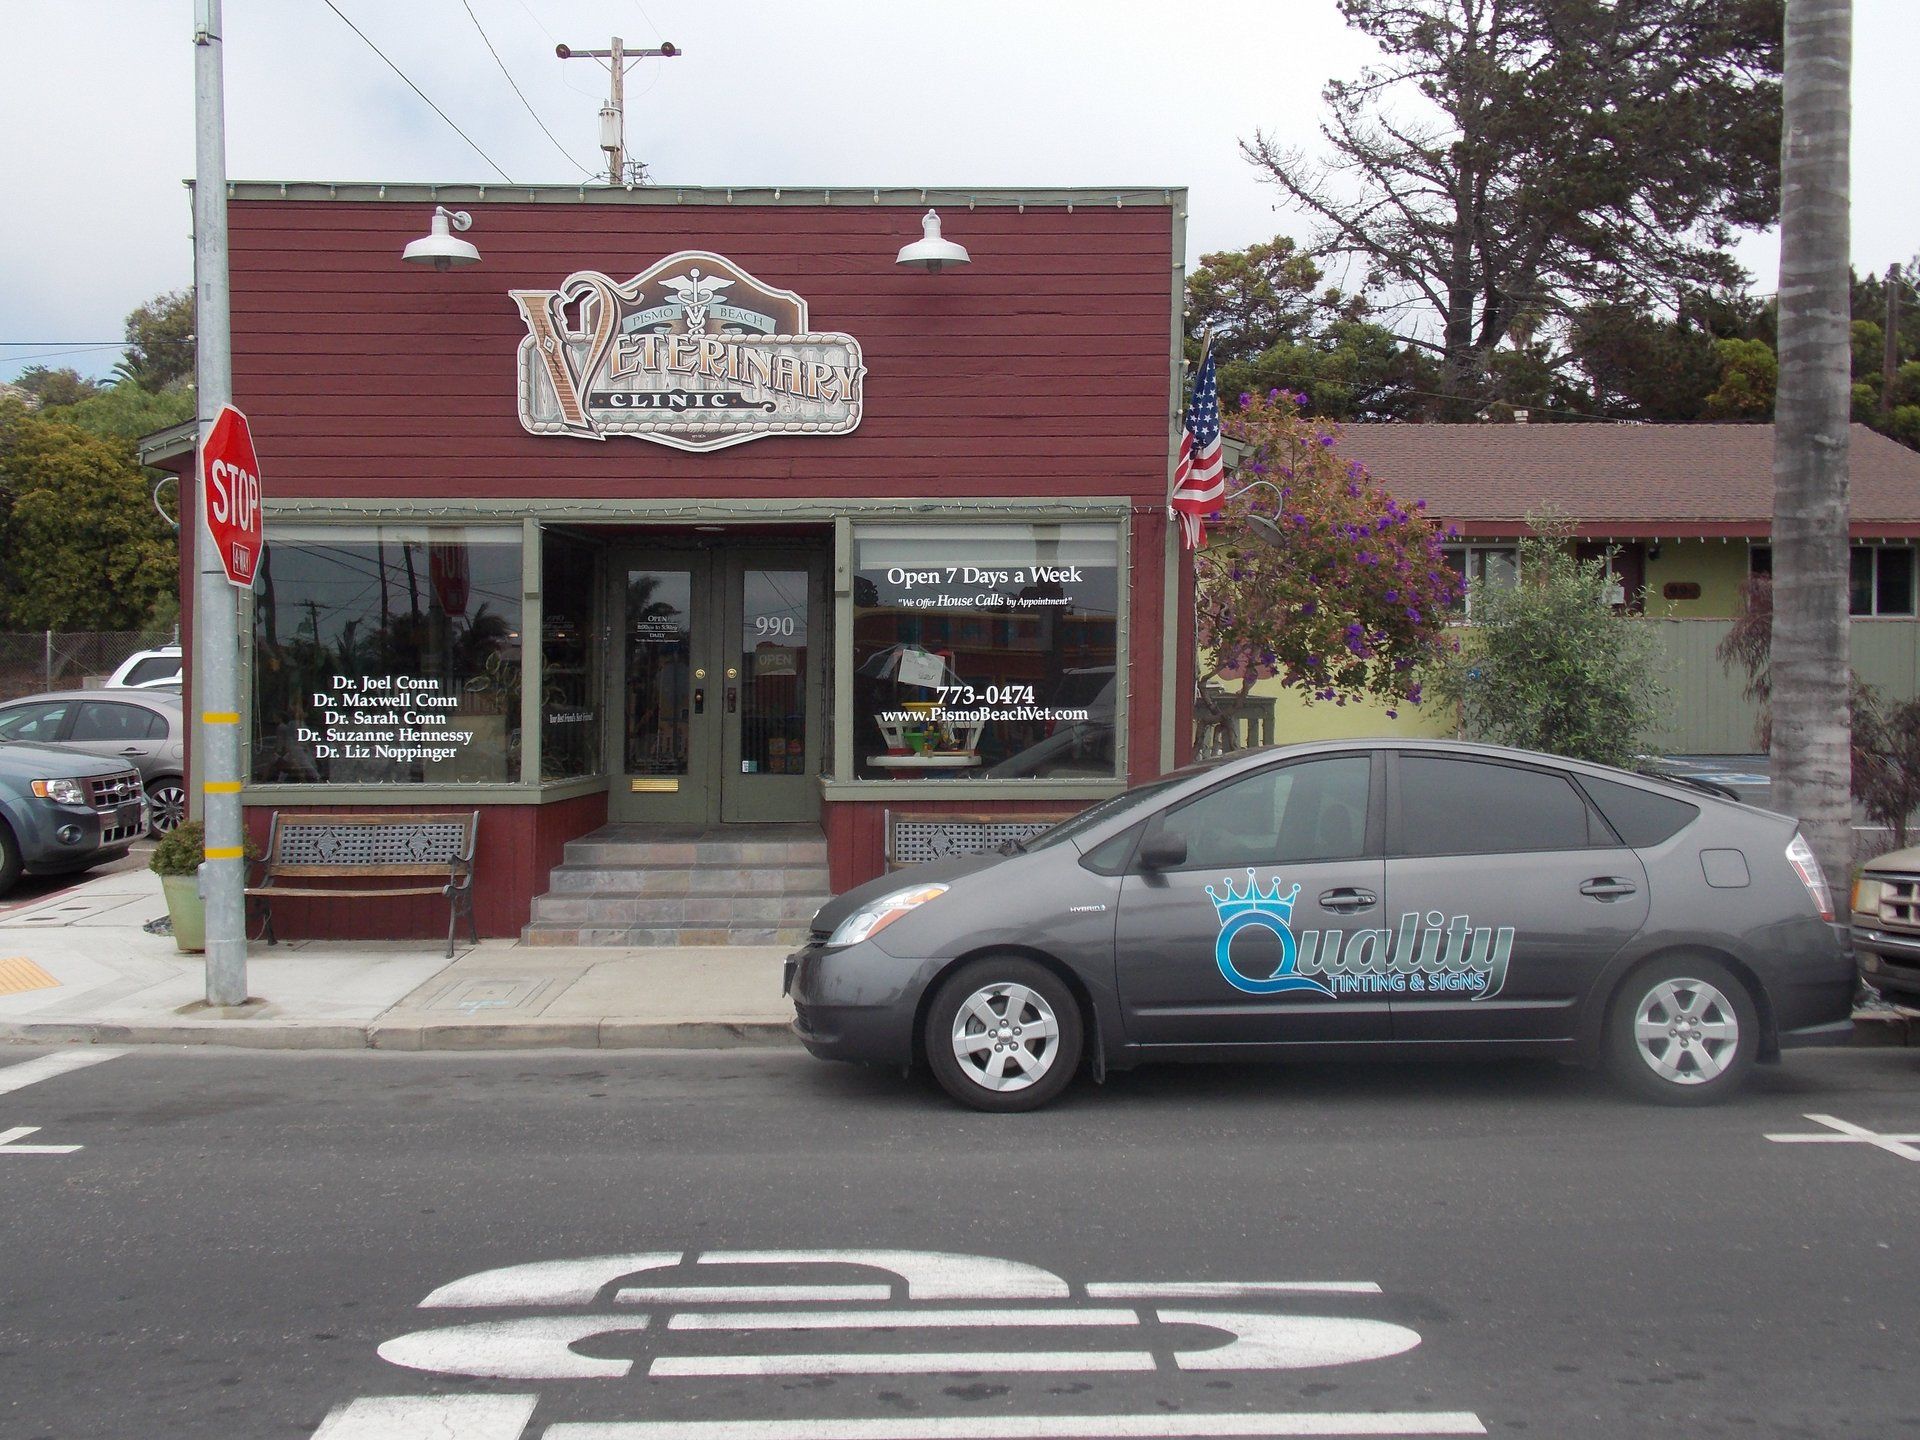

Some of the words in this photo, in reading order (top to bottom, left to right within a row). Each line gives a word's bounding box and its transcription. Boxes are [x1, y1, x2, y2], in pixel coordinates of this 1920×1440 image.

[632, 307, 674, 326] PISMO
[720, 307, 764, 327] BEACH
[508, 270, 860, 440] VETERINARY
[609, 393, 729, 408] CLINIC
[211, 458, 258, 533] STOP
[887, 567, 941, 589] Open
[946, 567, 958, 584] 7
[963, 567, 1009, 588] Days
[1014, 571, 1025, 583] a
[1030, 565, 1083, 583] Week
[916, 598, 936, 609] Offer
[937, 594, 973, 607] House
[975, 593, 1004, 607] Calls
[1006, 597, 1016, 608] by
[1017, 596, 1073, 608] Appointment"
[755, 616, 794, 636] 990
[759, 654, 792, 666] OPEN
[333, 676, 357, 690] Dr.
[361, 675, 391, 691] Joel
[396, 676, 439, 690] Conn
[313, 693, 338, 707] Dr.
[343, 693, 411, 707] Maxwell
[416, 693, 458, 707] Conn
[936, 685, 1035, 705] 773-0474
[325, 711, 349, 724] Dr.
[354, 710, 399, 724] Sarah
[404, 711, 446, 724] Conn
[881, 706, 1089, 722] www.PismoBeachVet.com
[297, 728, 321, 742] Dr.
[326, 728, 394, 742] Suzanne
[399, 728, 473, 745] Hennessy
[316, 745, 340, 758] Dr.
[345, 745, 370, 758] Liz
[375, 745, 457, 762] Noppinger
[1215, 909, 1515, 1001] Quality
[1326, 974, 1406, 993] TINTING
[1409, 974, 1425, 992] &
[1428, 972, 1486, 992] SIGNS
